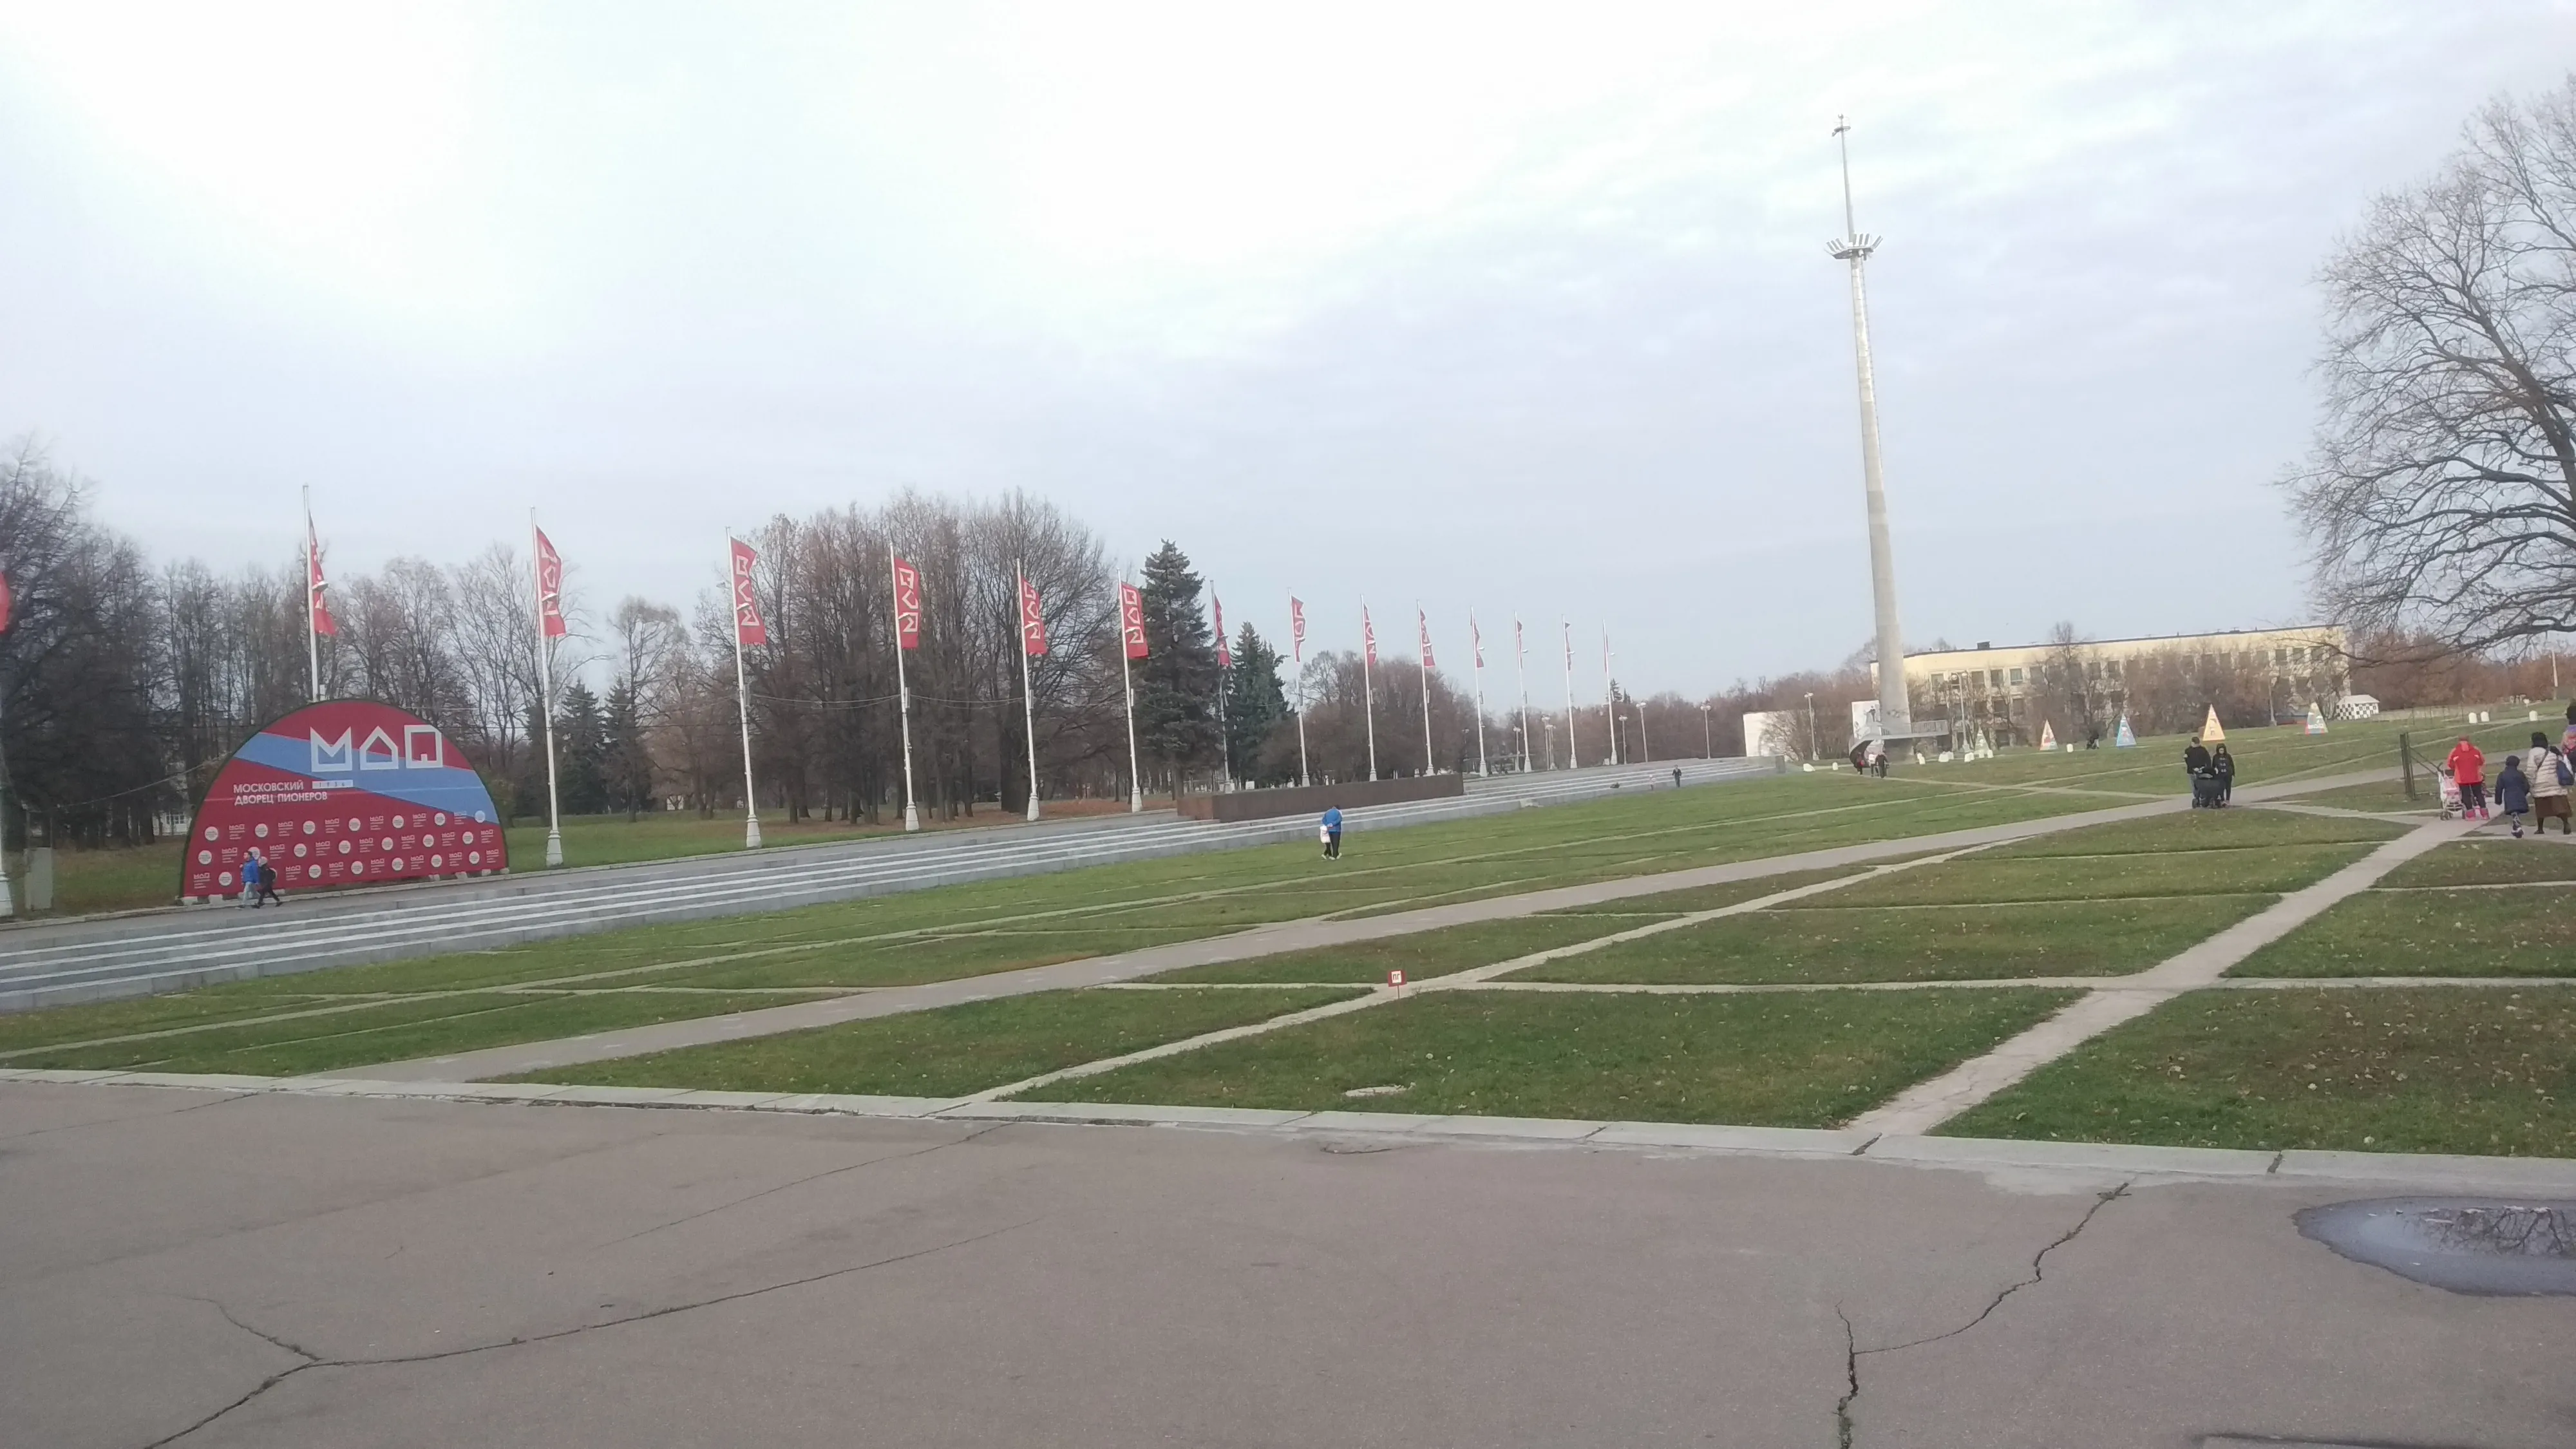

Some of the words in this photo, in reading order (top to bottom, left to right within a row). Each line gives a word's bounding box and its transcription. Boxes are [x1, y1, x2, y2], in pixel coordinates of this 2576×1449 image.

[233, 780, 304, 793] МОСКОВСКИЙ
[234, 795, 274, 806] ДВОРЕЦ
[278, 791, 327, 802] ПИОНЕРОВ
